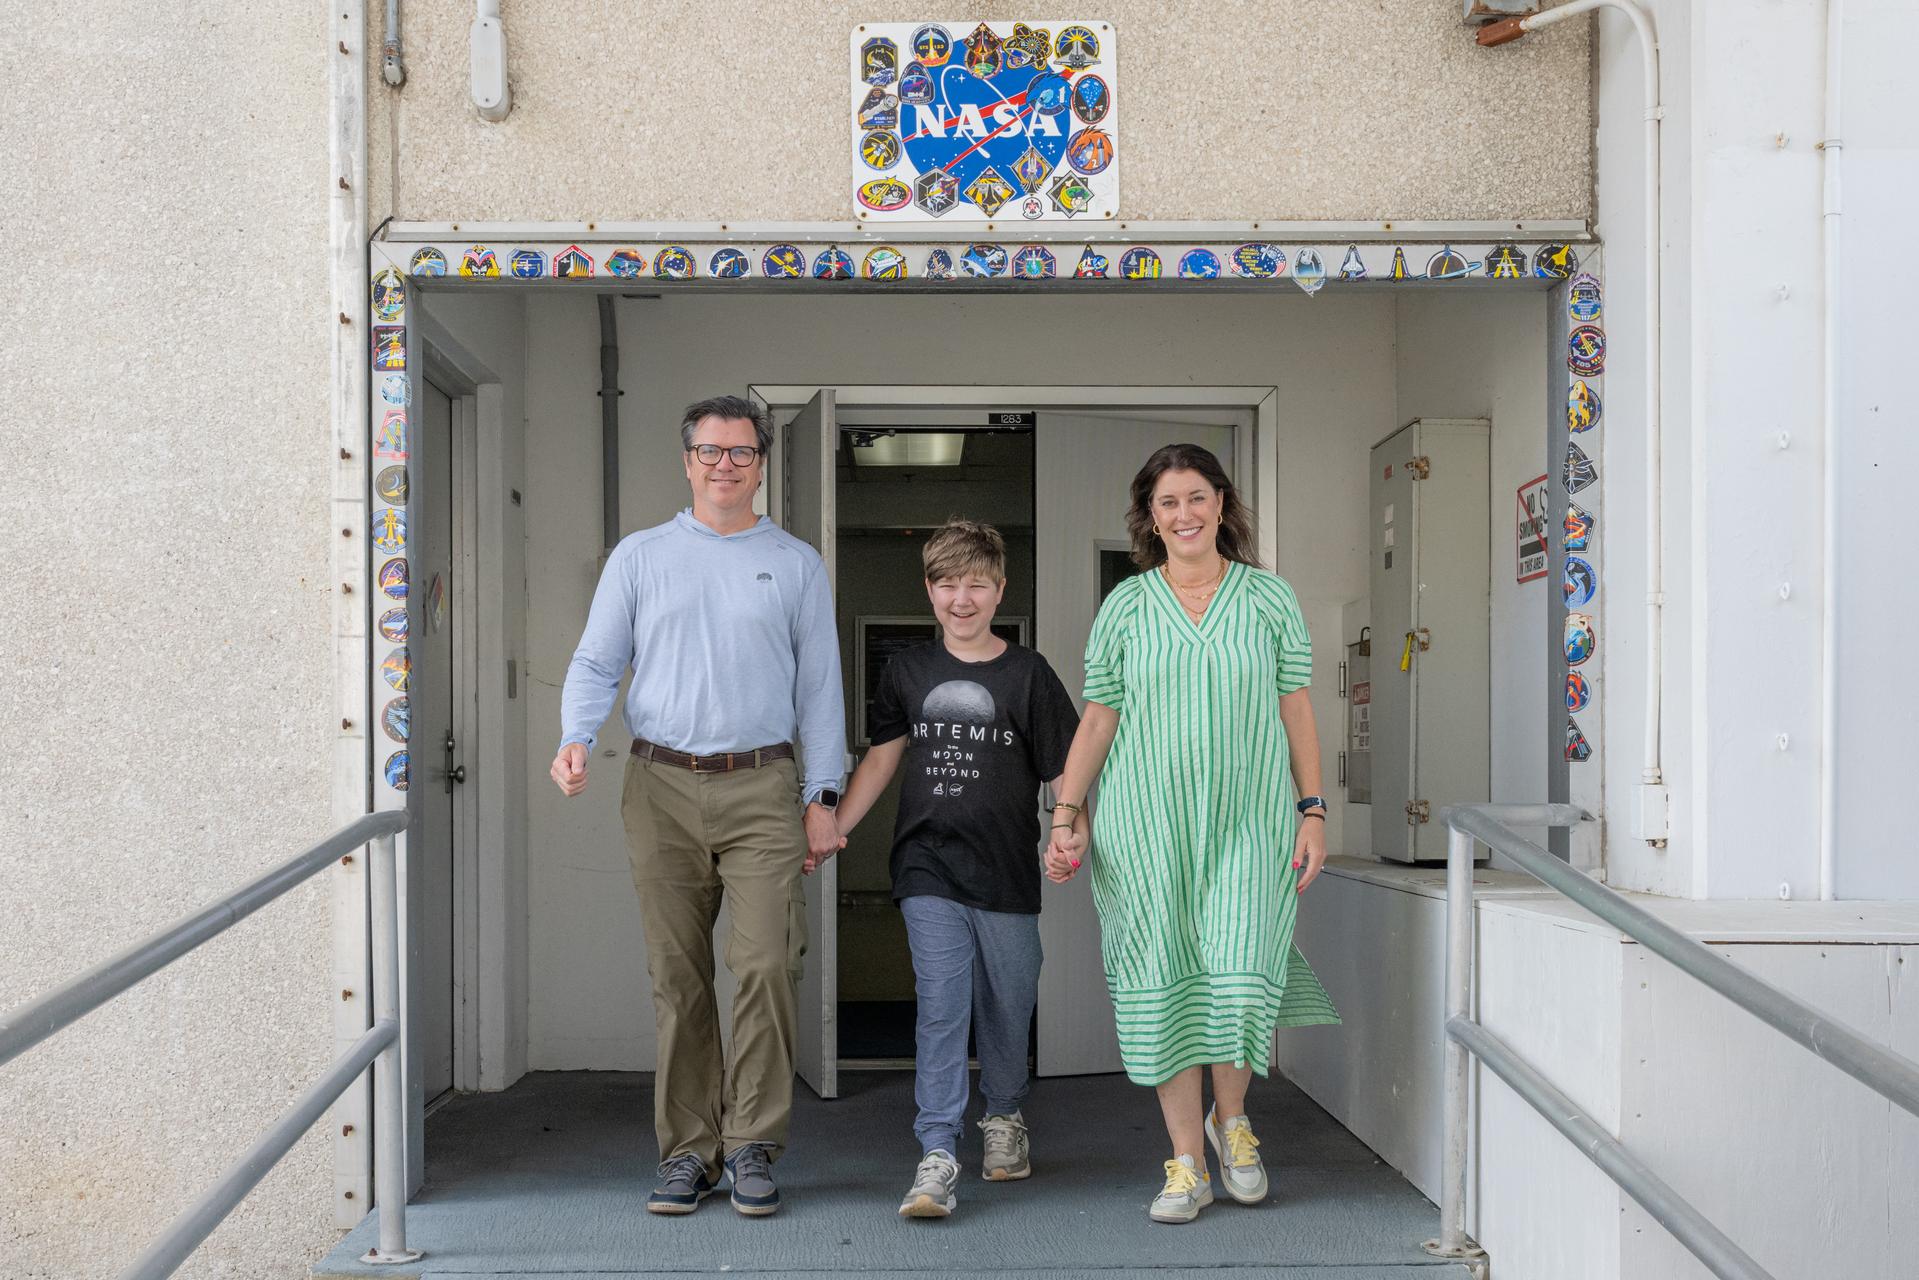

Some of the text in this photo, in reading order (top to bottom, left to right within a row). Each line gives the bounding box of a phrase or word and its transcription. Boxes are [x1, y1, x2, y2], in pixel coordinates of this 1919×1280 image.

[914, 103, 1062, 138] NASA
[1001, 414, 1021, 423] 1283
[1526, 493, 1535, 514] NO
[933, 750, 973, 761] MOON
[926, 766, 980, 778] BEYOND
